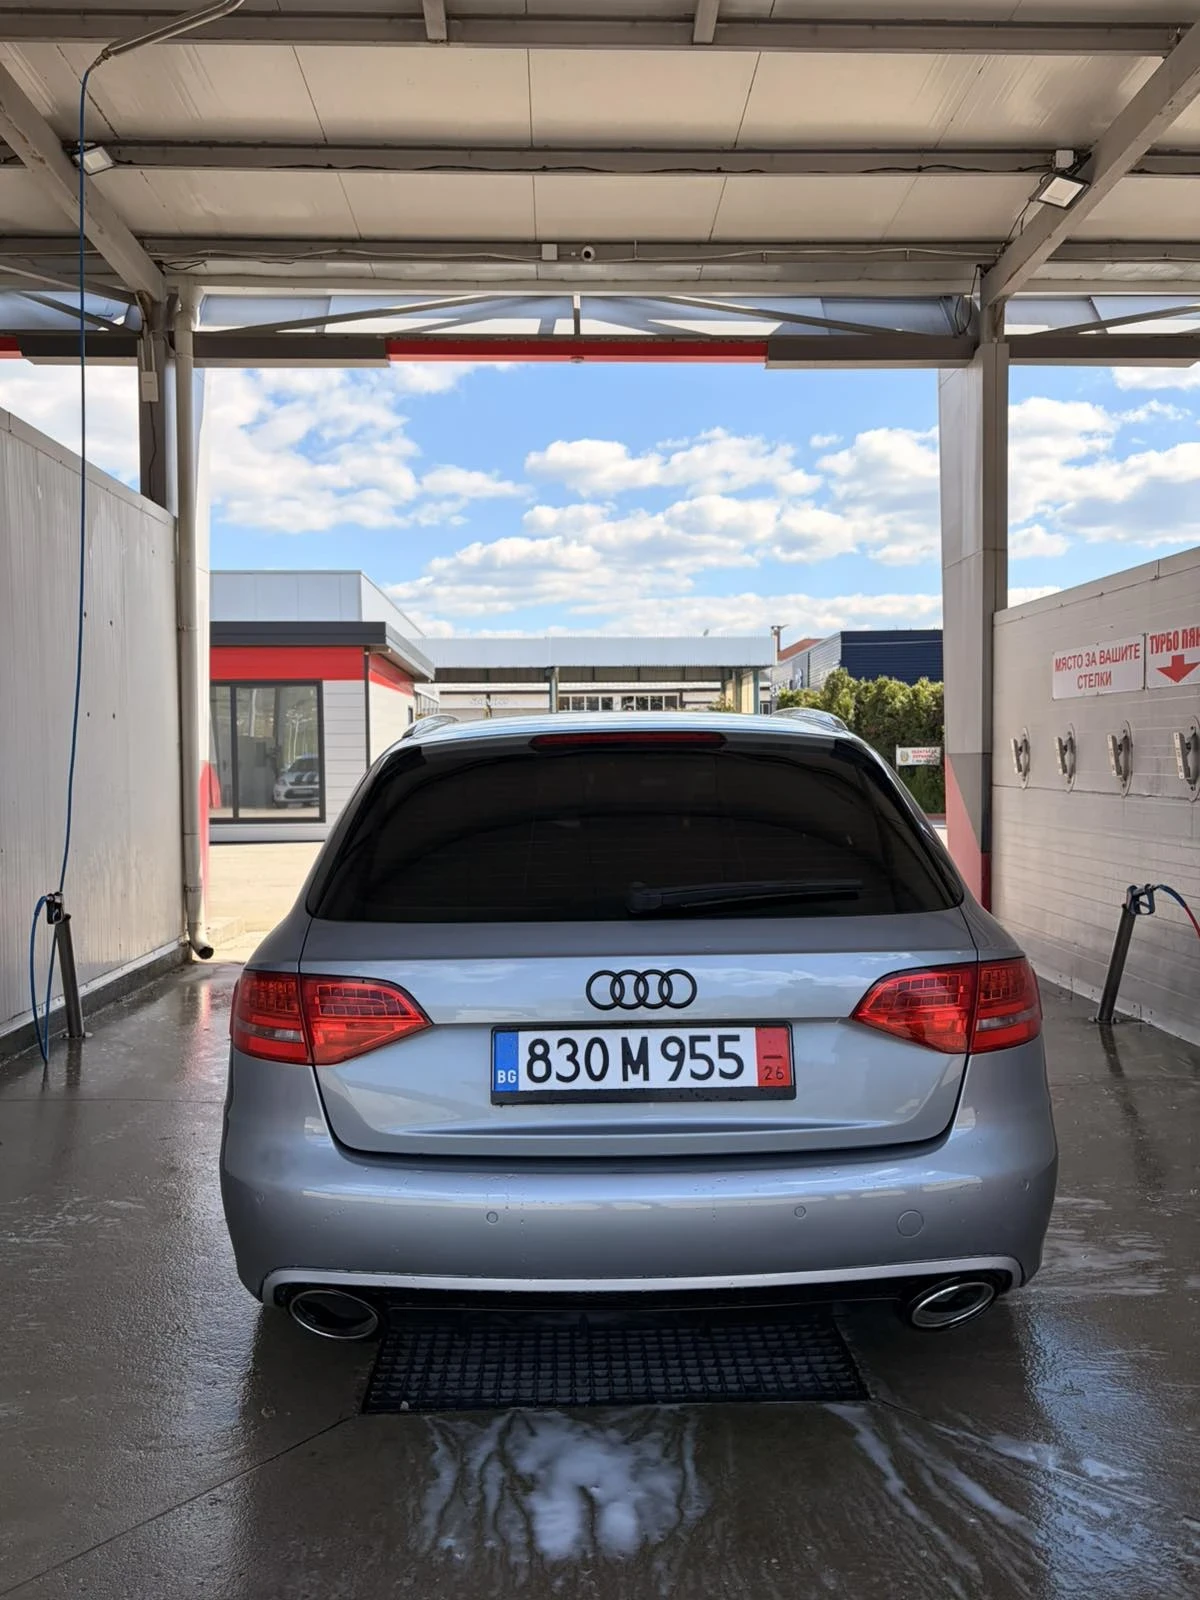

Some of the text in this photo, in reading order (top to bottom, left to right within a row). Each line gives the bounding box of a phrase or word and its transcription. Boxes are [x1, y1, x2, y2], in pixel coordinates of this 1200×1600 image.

[1150, 630, 1179, 655] ТУРБО
[1055, 643, 1141, 672] МЯСТО ЗА ВАШИТЕ
[1077, 671, 1112, 690] СТЕЛКИ
[526, 1034, 745, 1084] 830 M 955
[497, 1069, 517, 1084] BG
[764, 1065, 785, 1081] 26
